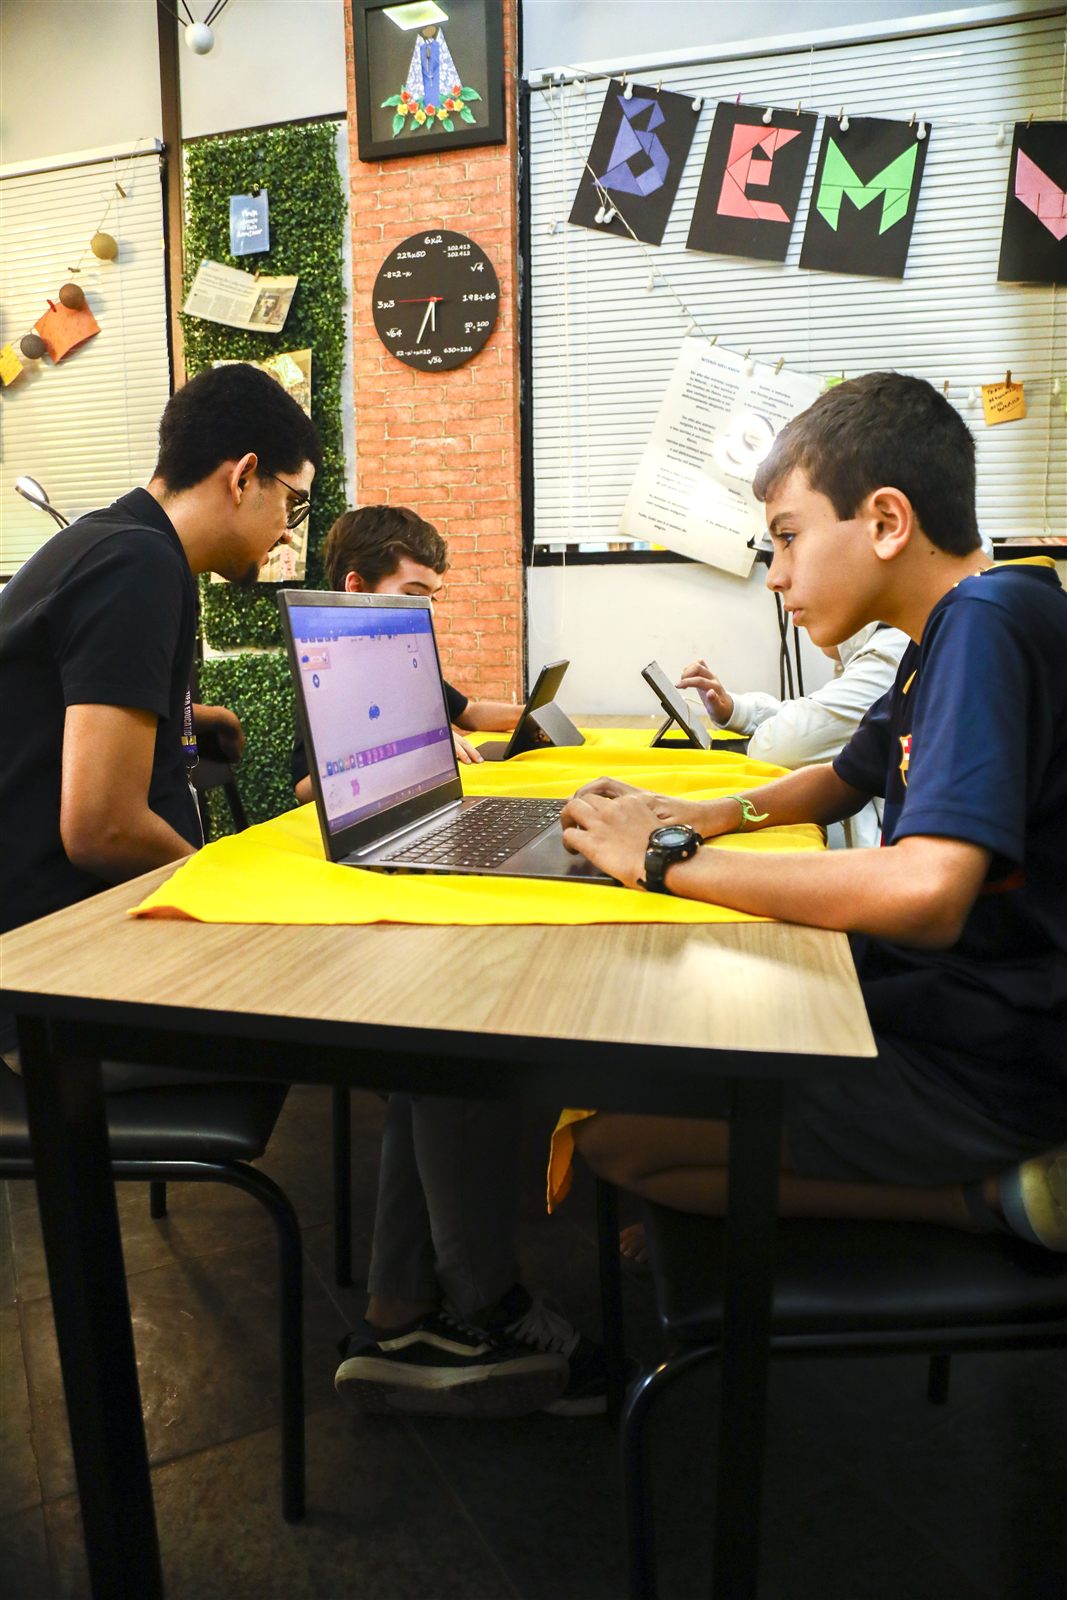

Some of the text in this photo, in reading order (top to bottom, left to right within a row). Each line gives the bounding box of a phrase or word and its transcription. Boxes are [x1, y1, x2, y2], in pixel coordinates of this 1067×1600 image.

[424, 235, 443, 244] 6x2
[377, 300, 395, 309] 3x3
[184, 706, 192, 736] EDUCATIO
